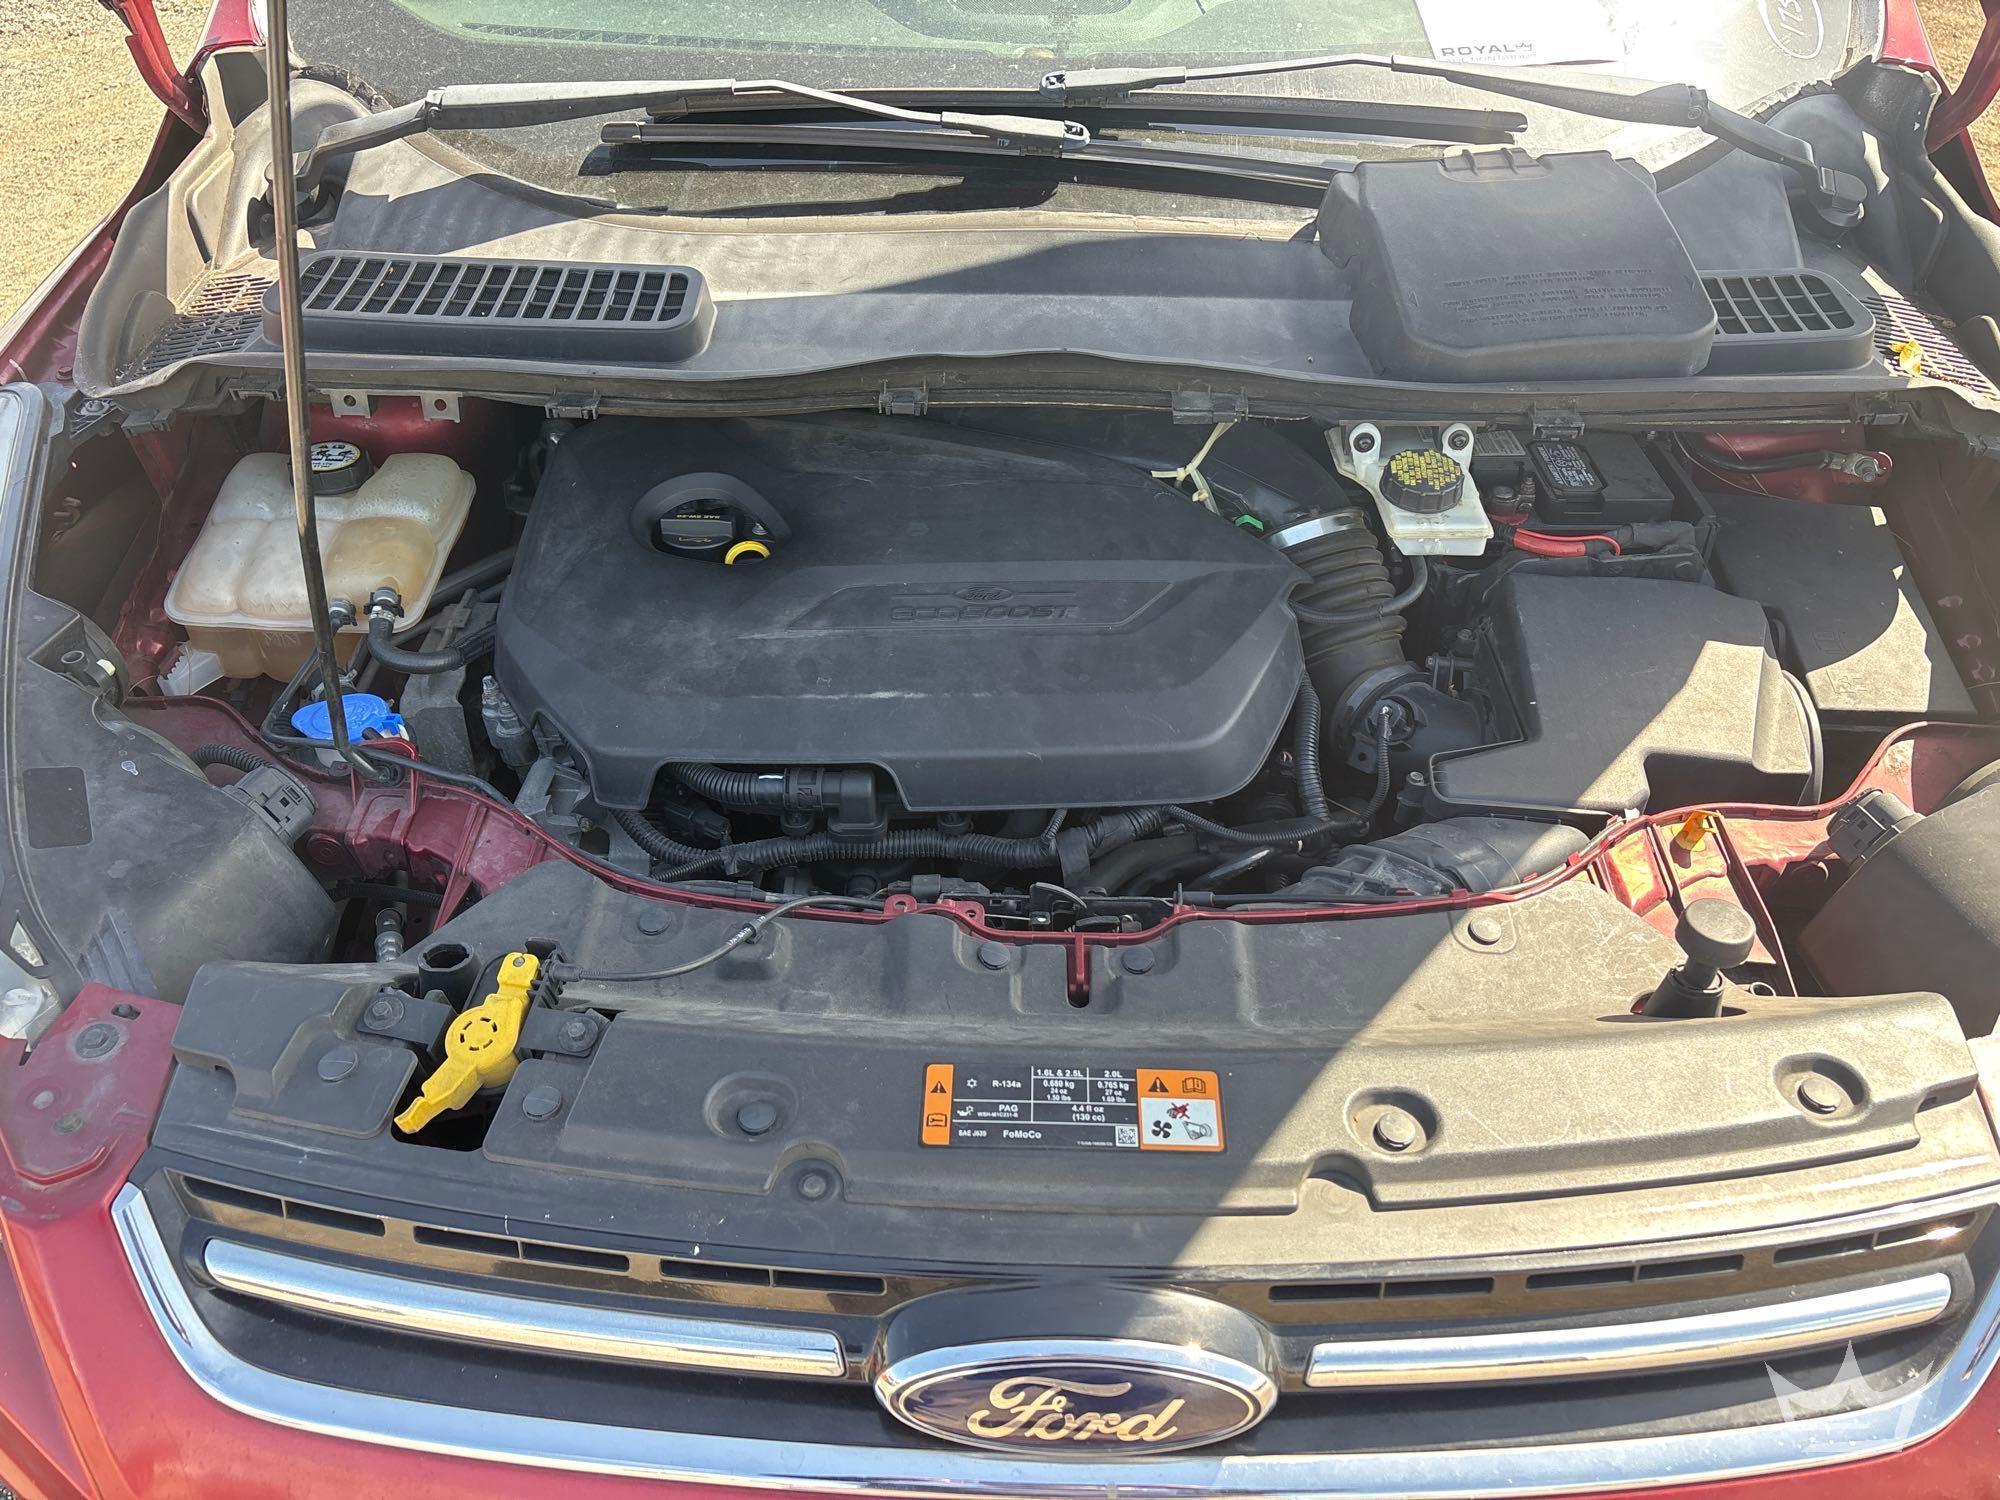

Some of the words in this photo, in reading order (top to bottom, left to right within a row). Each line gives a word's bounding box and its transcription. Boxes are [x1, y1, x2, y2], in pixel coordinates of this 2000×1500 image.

[1441, 44, 1516, 57] ROYAL
[890, 605, 1080, 621] ECOBOOST
[1104, 1070, 1122, 1078] 2.0L
[992, 1080, 1021, 1088] R-134a
[1064, 1080, 1074, 1089] kg
[1097, 1081, 1118, 1089] 0.765
[1119, 1082, 1129, 1091] kg
[999, 1104, 1018, 1112] PAG
[1092, 1114, 1105, 1122] cc)
[1003, 1130, 1042, 1139] FoMoCo
[967, 1376, 1186, 1442] Ford
